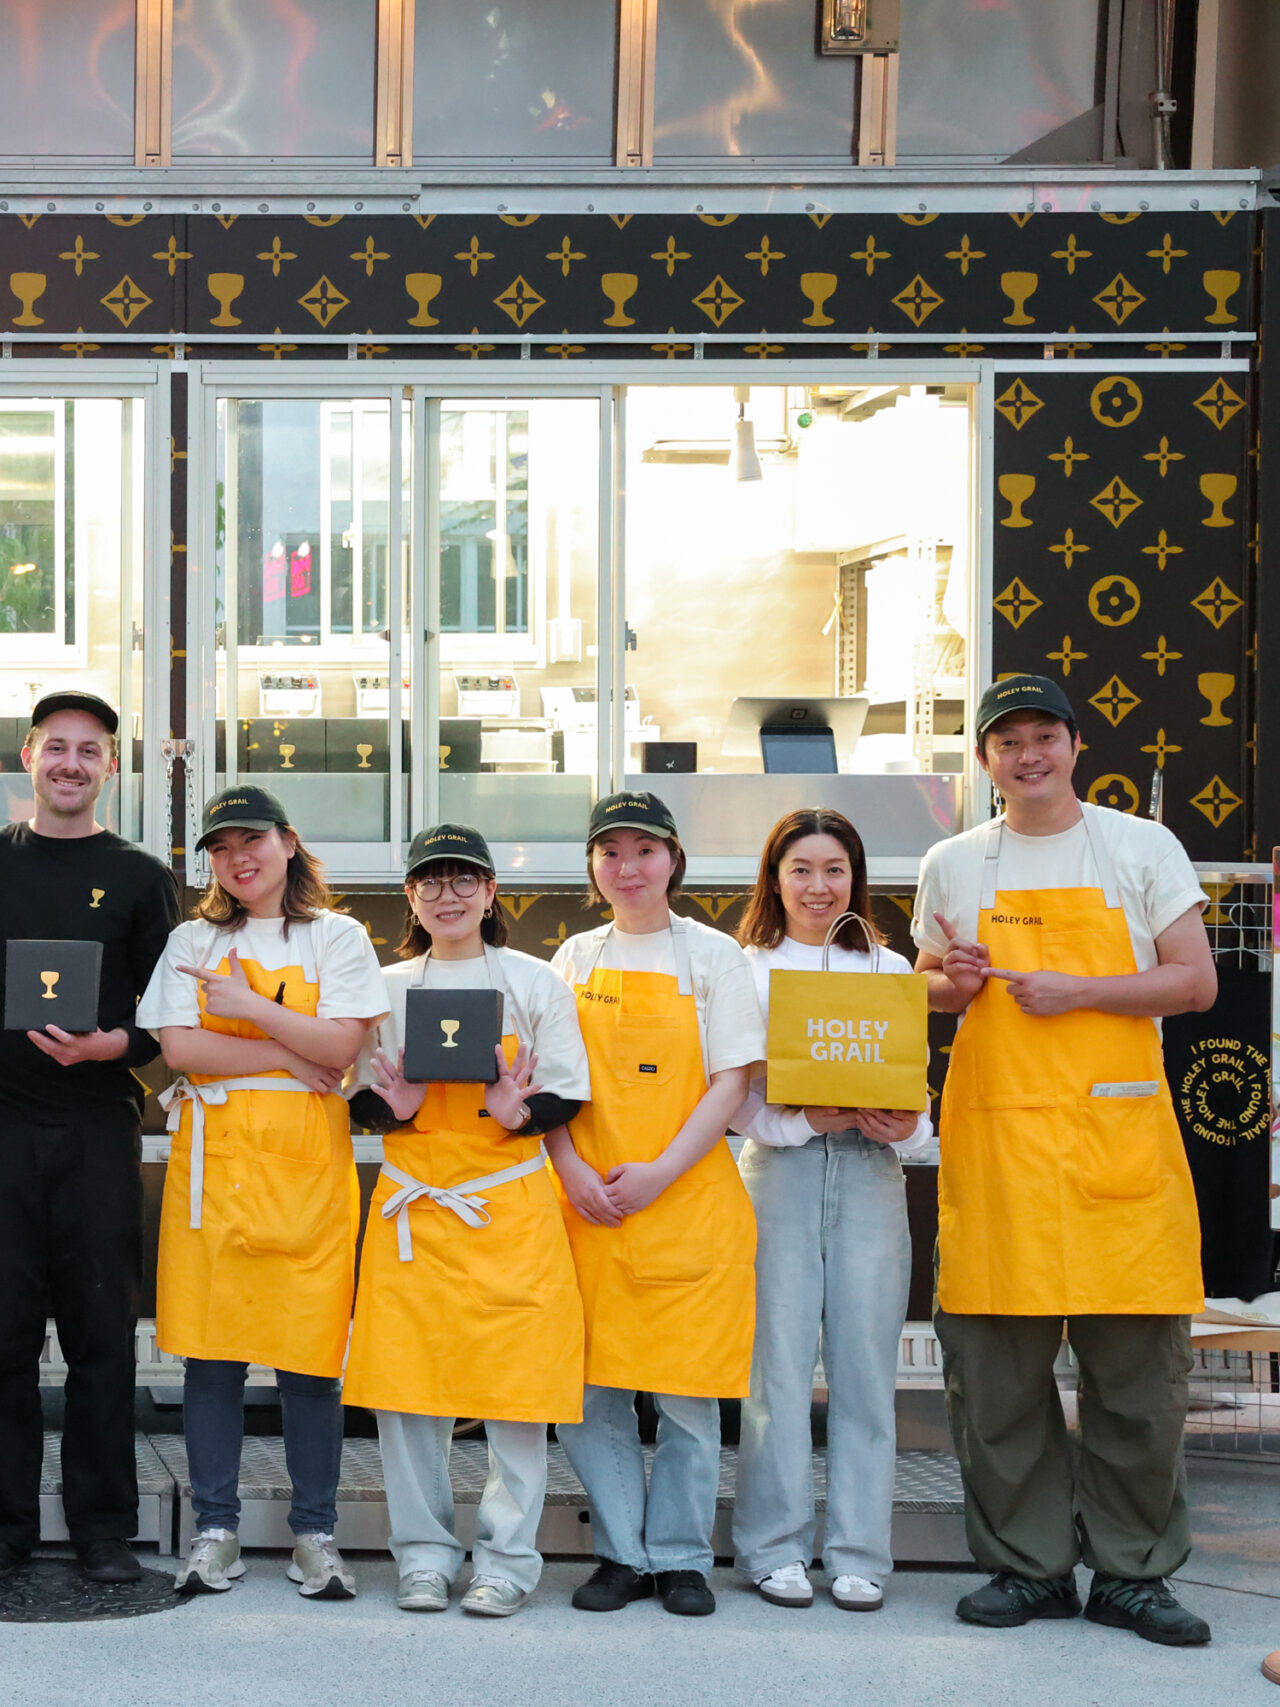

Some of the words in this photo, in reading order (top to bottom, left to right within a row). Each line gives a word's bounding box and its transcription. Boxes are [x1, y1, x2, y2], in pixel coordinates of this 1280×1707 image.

[997, 687, 1020, 700] HOLEY
[1021, 686, 1044, 694] GRAIL
[209, 801, 227, 816] HOLEY
[227, 798, 249, 806] GRAIL
[604, 801, 627, 813] HOLEY
[627, 801, 649, 810] GRAIL
[424, 834, 446, 846] HOLEY
[447, 834, 468, 843] GRAIL
[991, 914, 1021, 925] HOLEY
[1022, 916, 1044, 926] GRAIL
[806, 1018, 889, 1040] HOLEY
[810, 1041, 886, 1063] GRAIL
[1191, 1046, 1197, 1055] I
[1199, 1038, 1241, 1051] FOUND
[1246, 1045, 1268, 1067] THE
[1211, 1053, 1246, 1074] GRAIL.
[1181, 1057, 1206, 1093] HOLEY
[1212, 1071, 1244, 1094] GRAIL.
[1181, 1098, 1194, 1123] THE
[1196, 1080, 1215, 1121] HOLEY
[1239, 1083, 1262, 1124] FOUND
[1193, 1123, 1231, 1146] FOUND
[1215, 1117, 1237, 1130] THE
